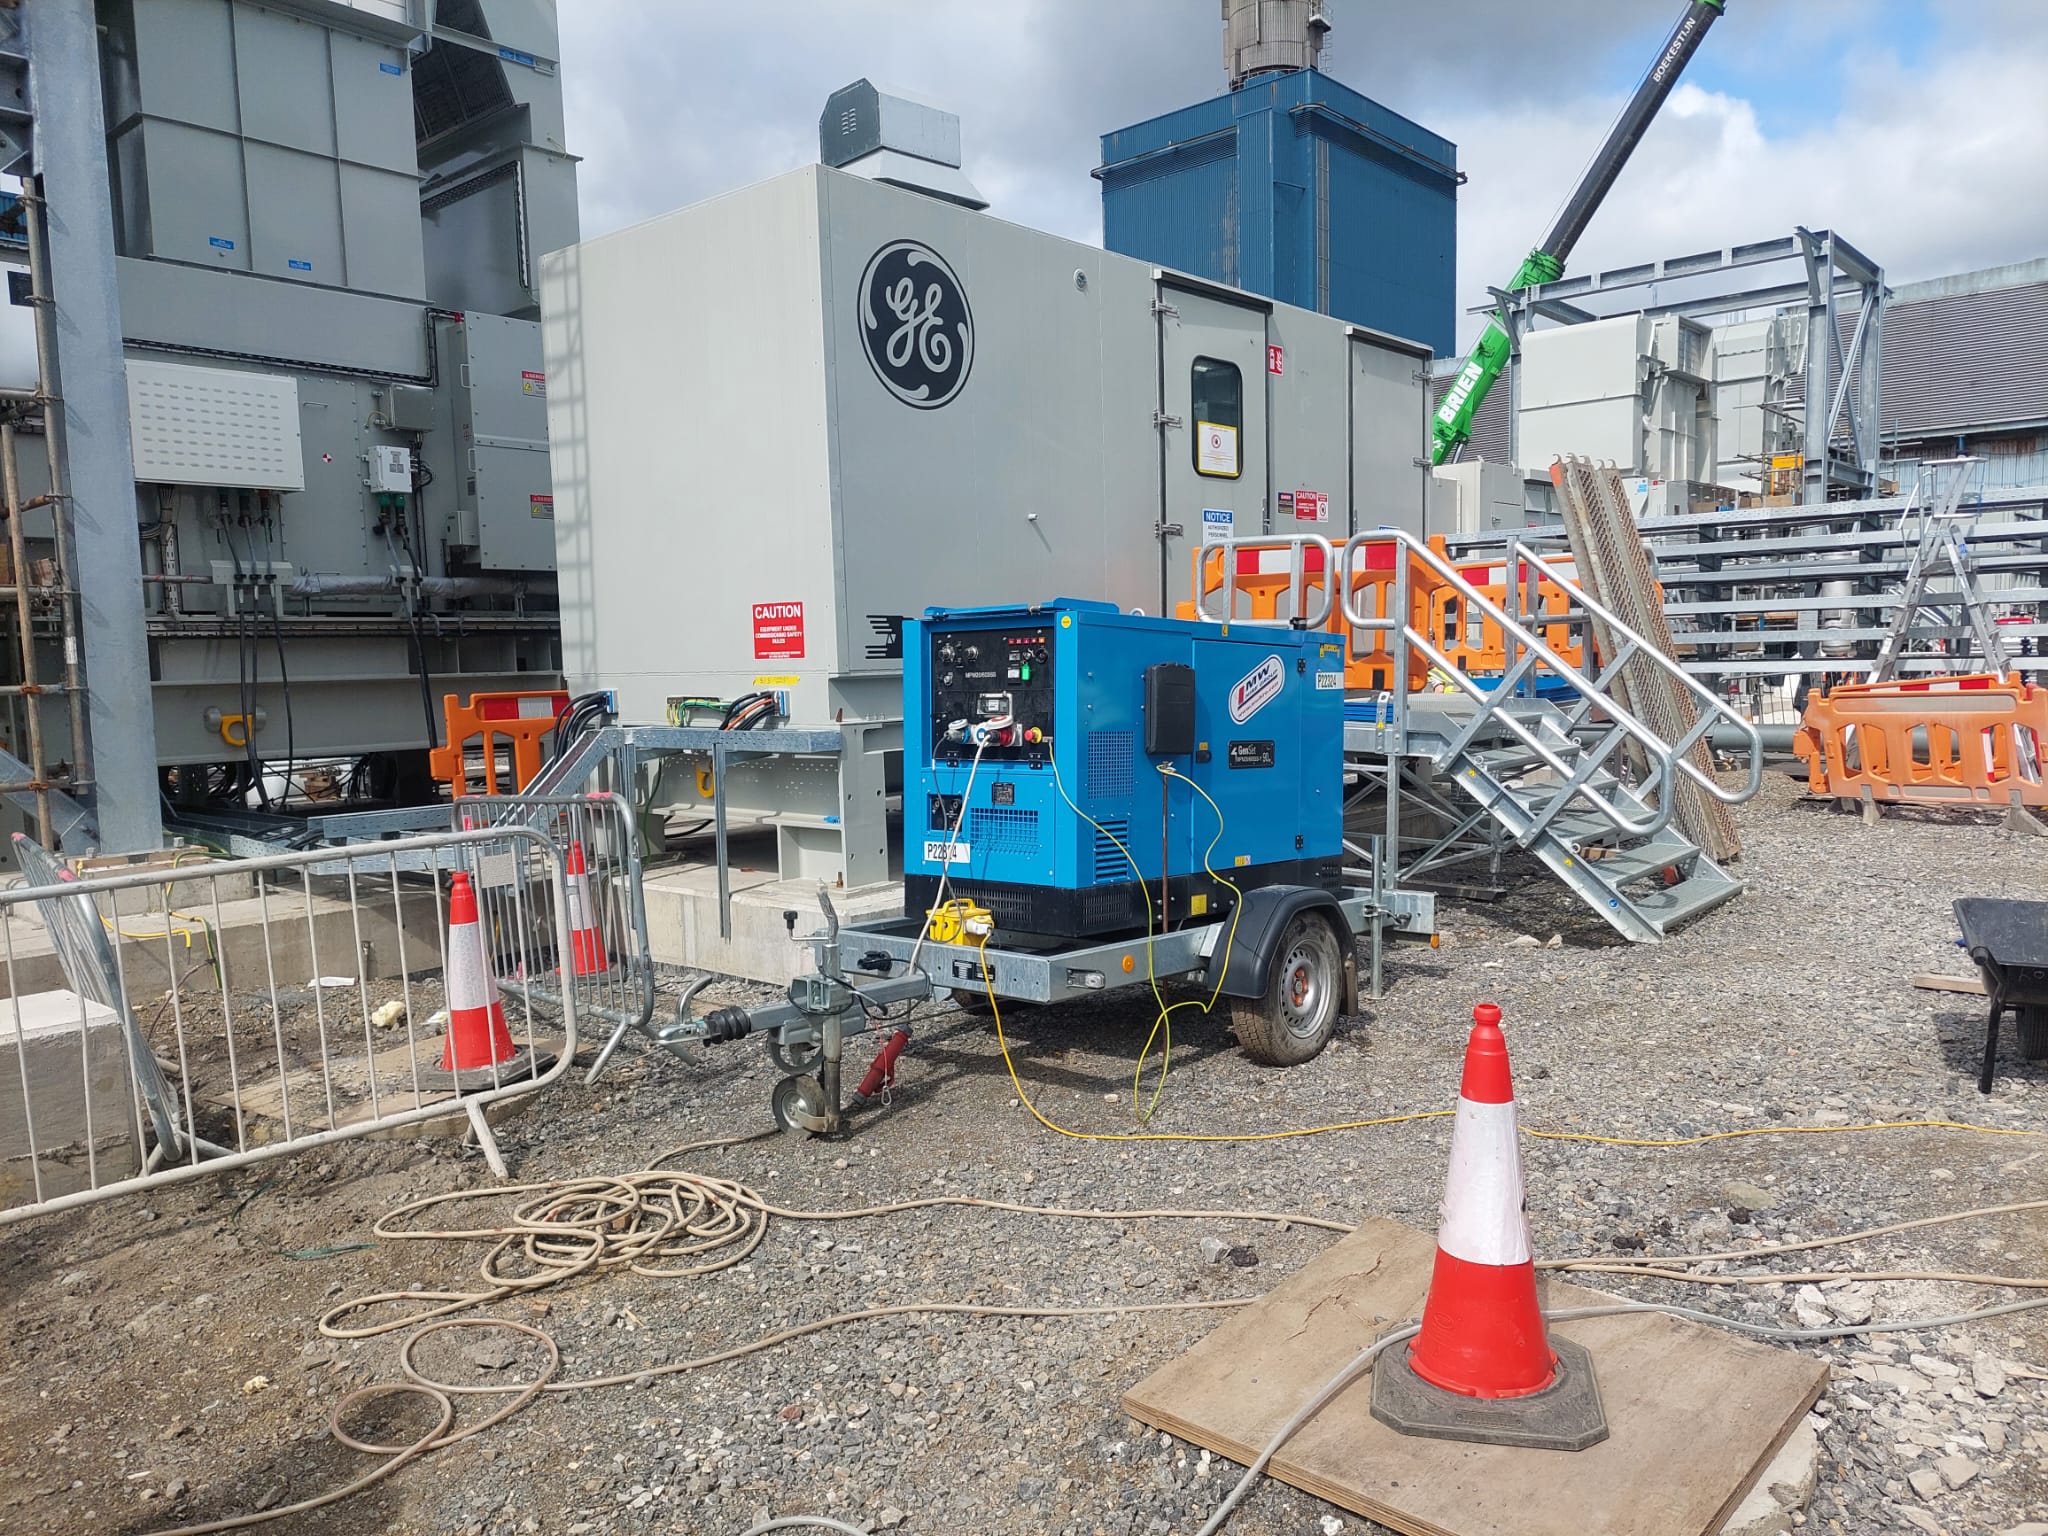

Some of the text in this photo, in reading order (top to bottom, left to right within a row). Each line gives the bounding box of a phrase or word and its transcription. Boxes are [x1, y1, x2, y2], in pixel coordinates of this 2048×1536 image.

[1653, 17, 1697, 82] BOEKESTIJN
[1438, 361, 1484, 424] BRIEN
[1205, 511, 1231, 522] NOTICE
[755, 605, 801, 619] CAUTION
[1317, 674, 1337, 688] P22324
